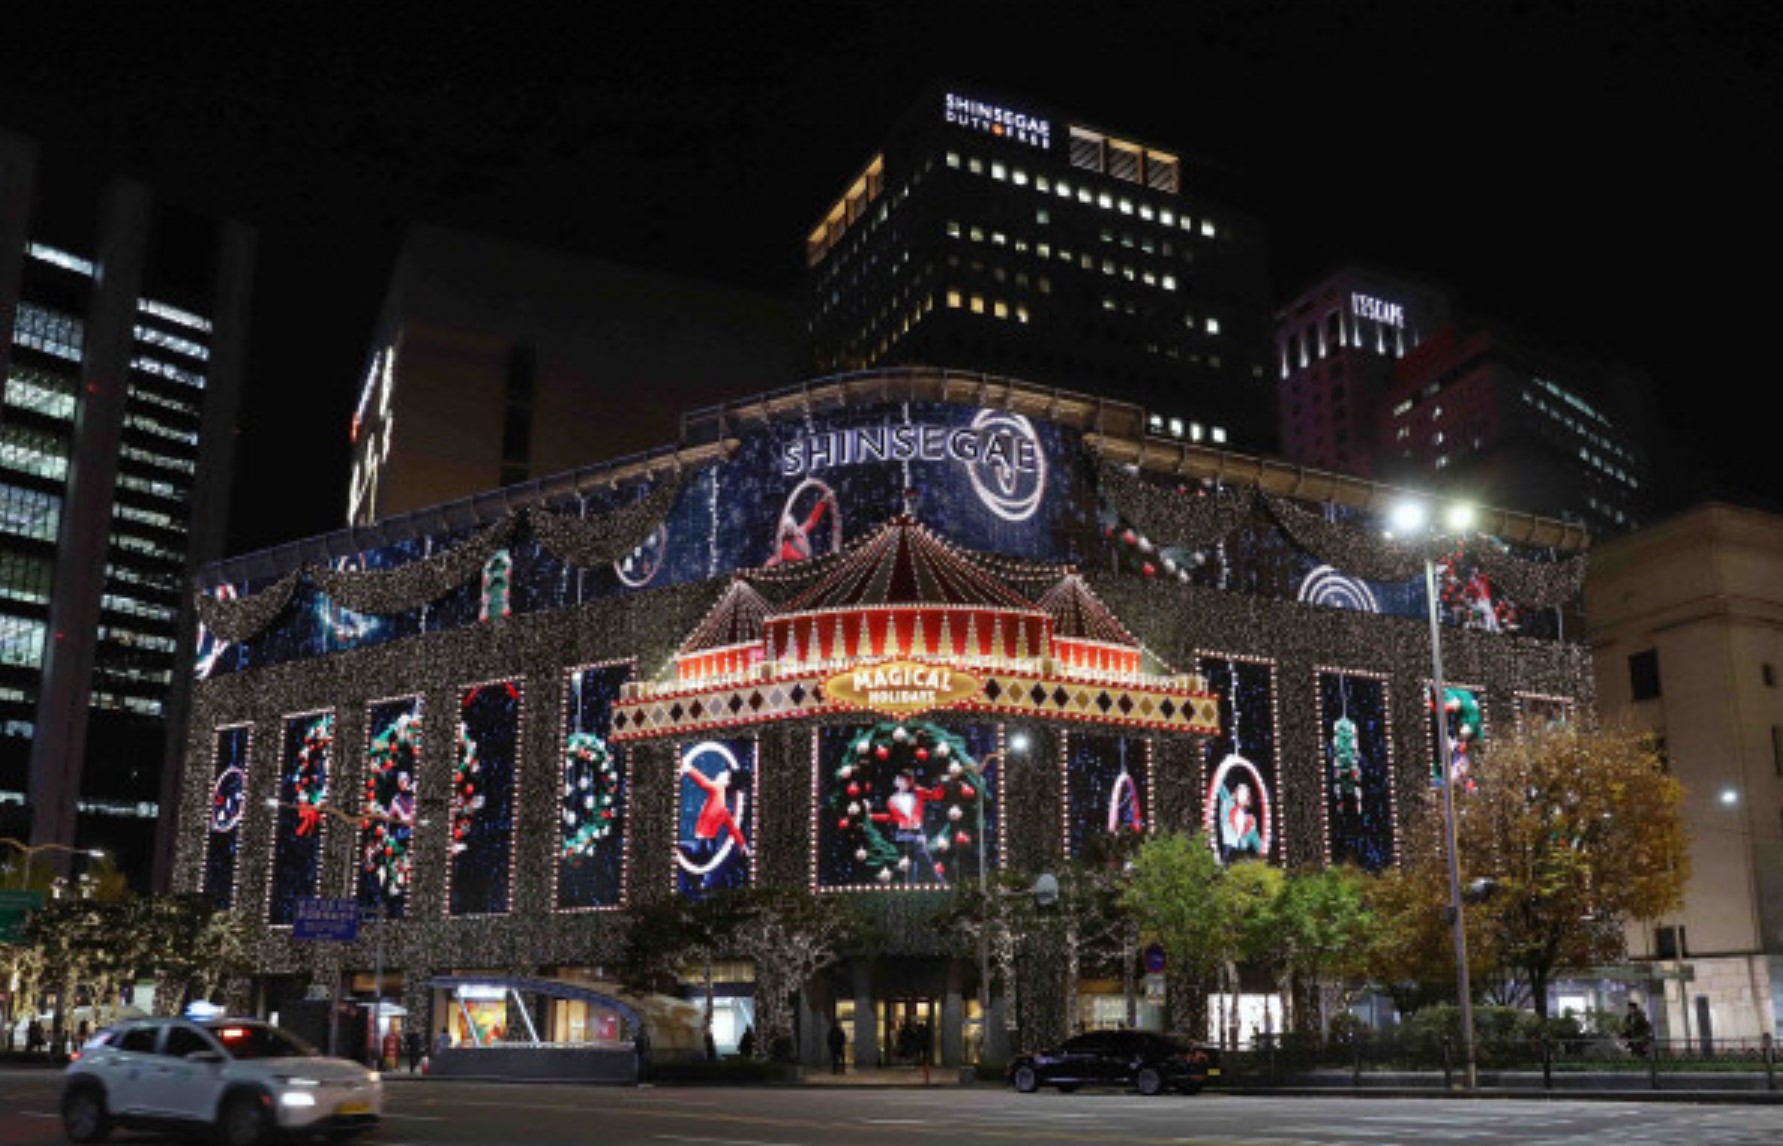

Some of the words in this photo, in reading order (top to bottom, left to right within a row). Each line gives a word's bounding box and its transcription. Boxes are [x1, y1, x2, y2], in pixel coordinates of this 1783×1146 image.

[945, 92, 1050, 135] SHINSEGAE
[946, 109, 991, 132] DUTY
[782, 426, 1036, 476] SHINSEGAE
[852, 666, 953, 692] MAGICAL
